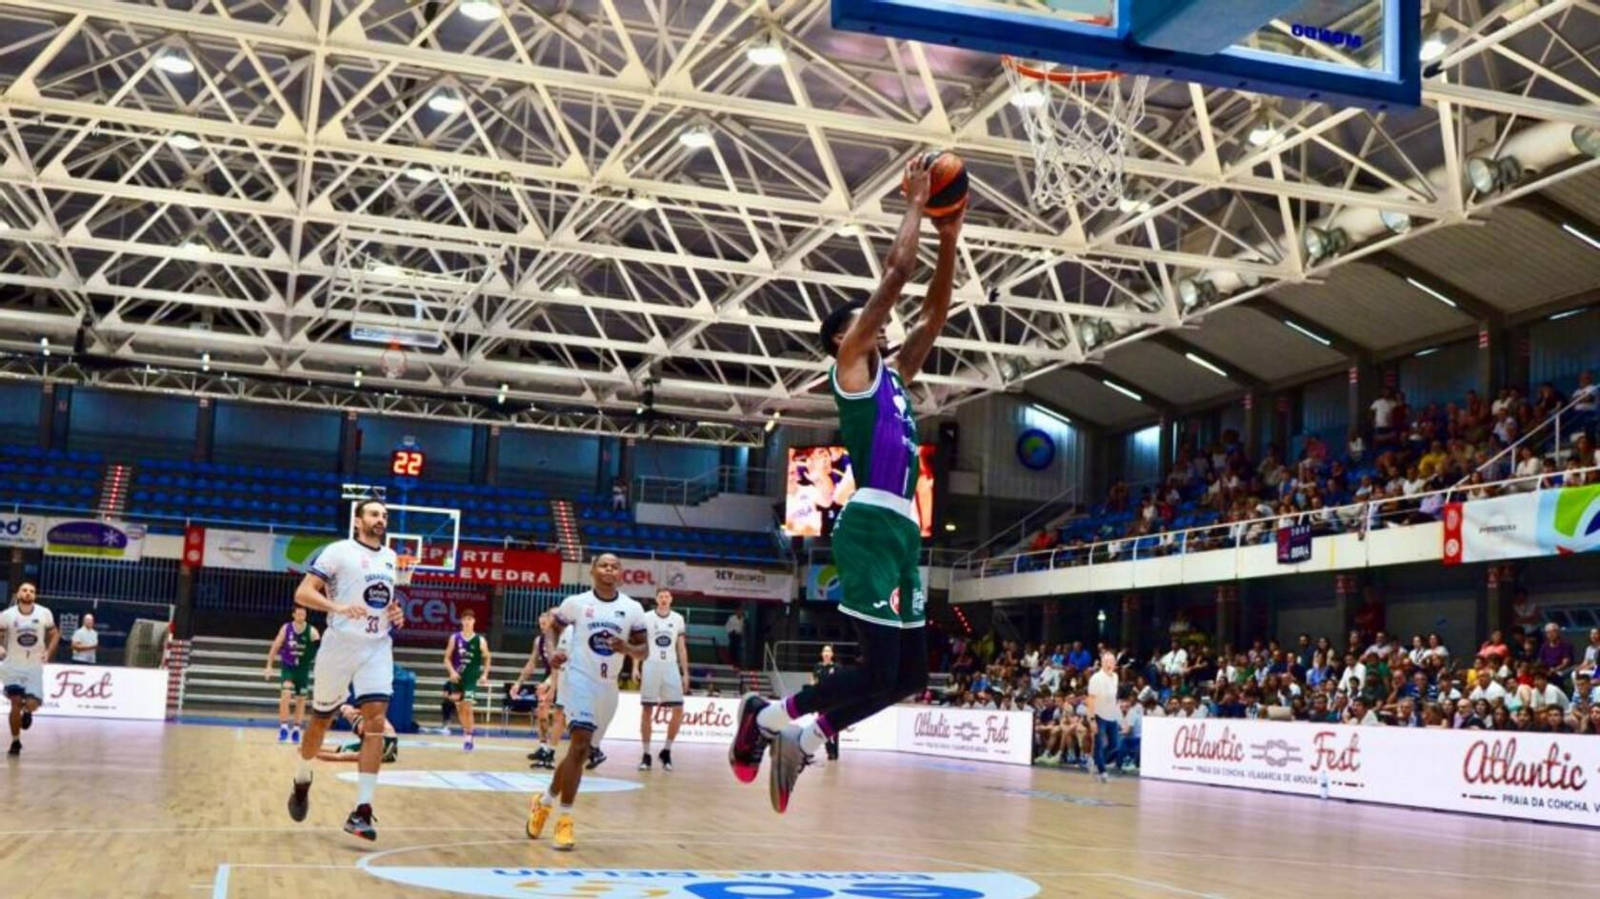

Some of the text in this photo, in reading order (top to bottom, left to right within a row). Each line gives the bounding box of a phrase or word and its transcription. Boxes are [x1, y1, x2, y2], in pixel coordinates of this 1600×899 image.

[394, 451, 422, 475] 22
[365, 615, 380, 633] 33
[51, 670, 114, 699] Fest
[654, 702, 734, 726] tantic
[914, 712, 1010, 743] Atlantic Fest
[1173, 723, 1361, 771] Atlantic Fest
[1463, 737, 1587, 791] Atlantic
[1283, 773, 1292, 782] DE
[1502, 794, 1529, 806] PRAIA
[1531, 796, 1545, 807] DA
